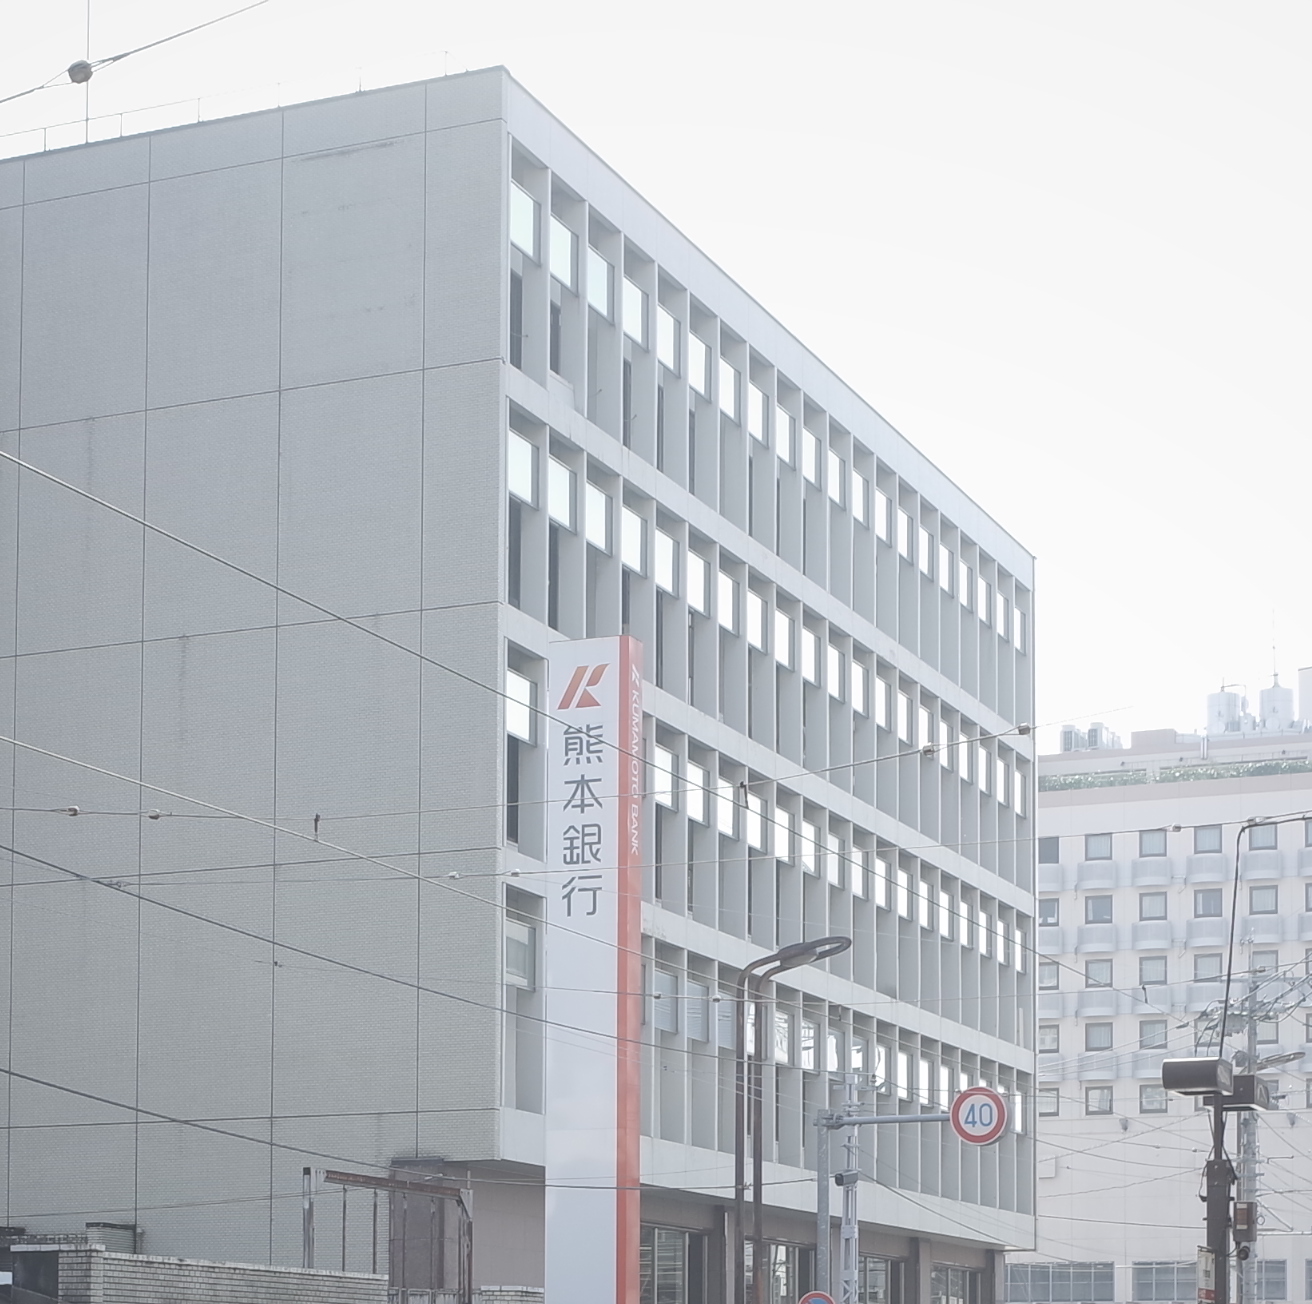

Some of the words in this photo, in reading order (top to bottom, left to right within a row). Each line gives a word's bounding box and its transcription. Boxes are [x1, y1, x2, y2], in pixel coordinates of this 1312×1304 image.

[561, 723, 604, 917] 熊本銀行
[631, 803, 639, 855] BANK
[964, 1103, 993, 1128] 40
